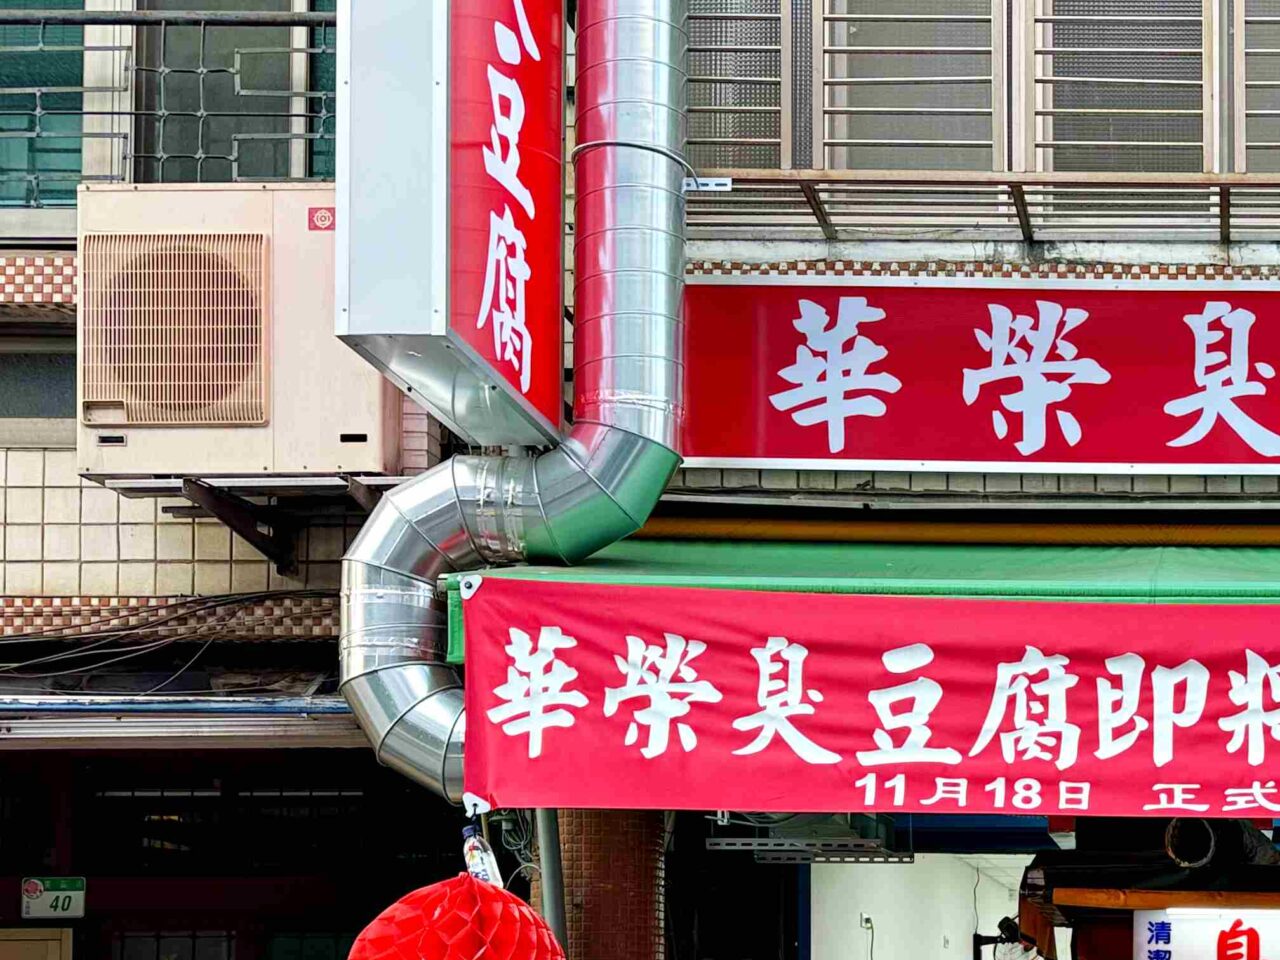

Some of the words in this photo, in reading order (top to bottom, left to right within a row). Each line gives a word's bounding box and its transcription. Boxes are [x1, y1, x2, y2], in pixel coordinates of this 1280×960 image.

[477, 0, 541, 394] 豆腐
[855, 773, 1091, 811] 11月18日
[49, 895, 72, 912] 40
